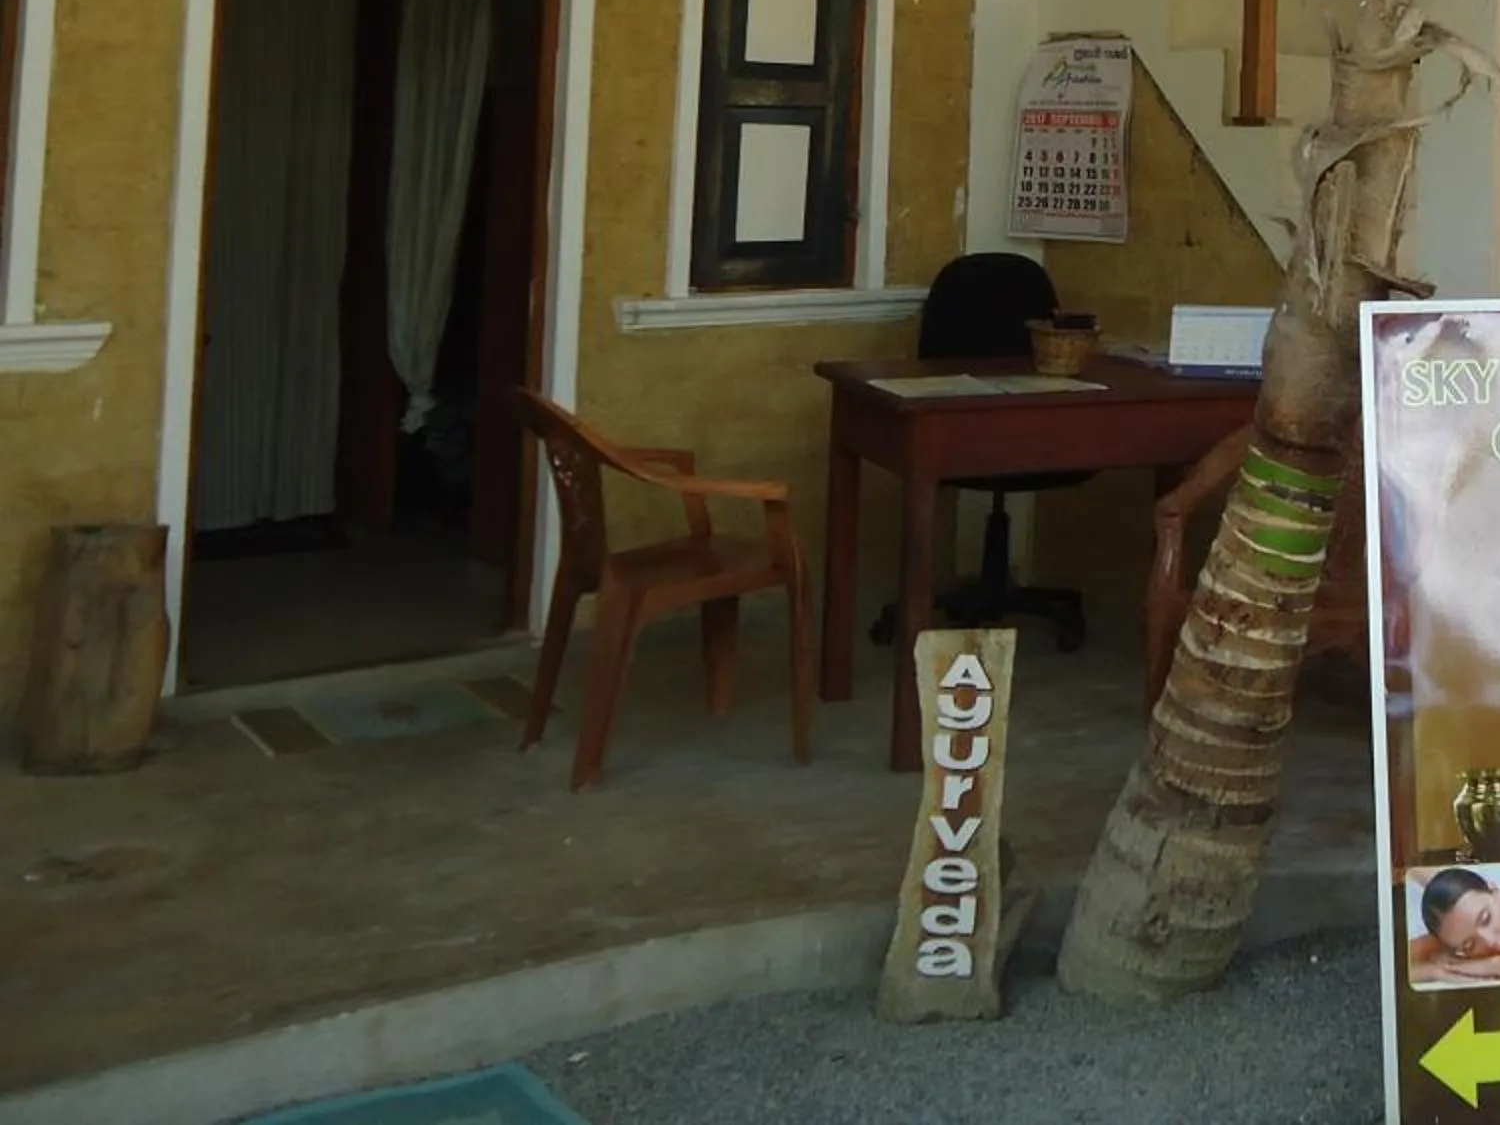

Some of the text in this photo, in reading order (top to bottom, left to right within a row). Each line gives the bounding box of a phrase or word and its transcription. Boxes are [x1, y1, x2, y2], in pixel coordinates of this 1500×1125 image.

[1025, 149, 1033, 162] 4
[1070, 167, 1080, 178] 14
[1069, 183, 1080, 194] 21
[1084, 184, 1096, 195] 22
[1017, 196, 1033, 207] 25
[1035, 197, 1049, 208] 26
[1053, 197, 1064, 208] 27
[1067, 198, 1080, 209] 28
[1083, 198, 1096, 209] 29
[1401, 358, 1499, 407] SKY
[916, 654, 993, 976] Ayurveda
